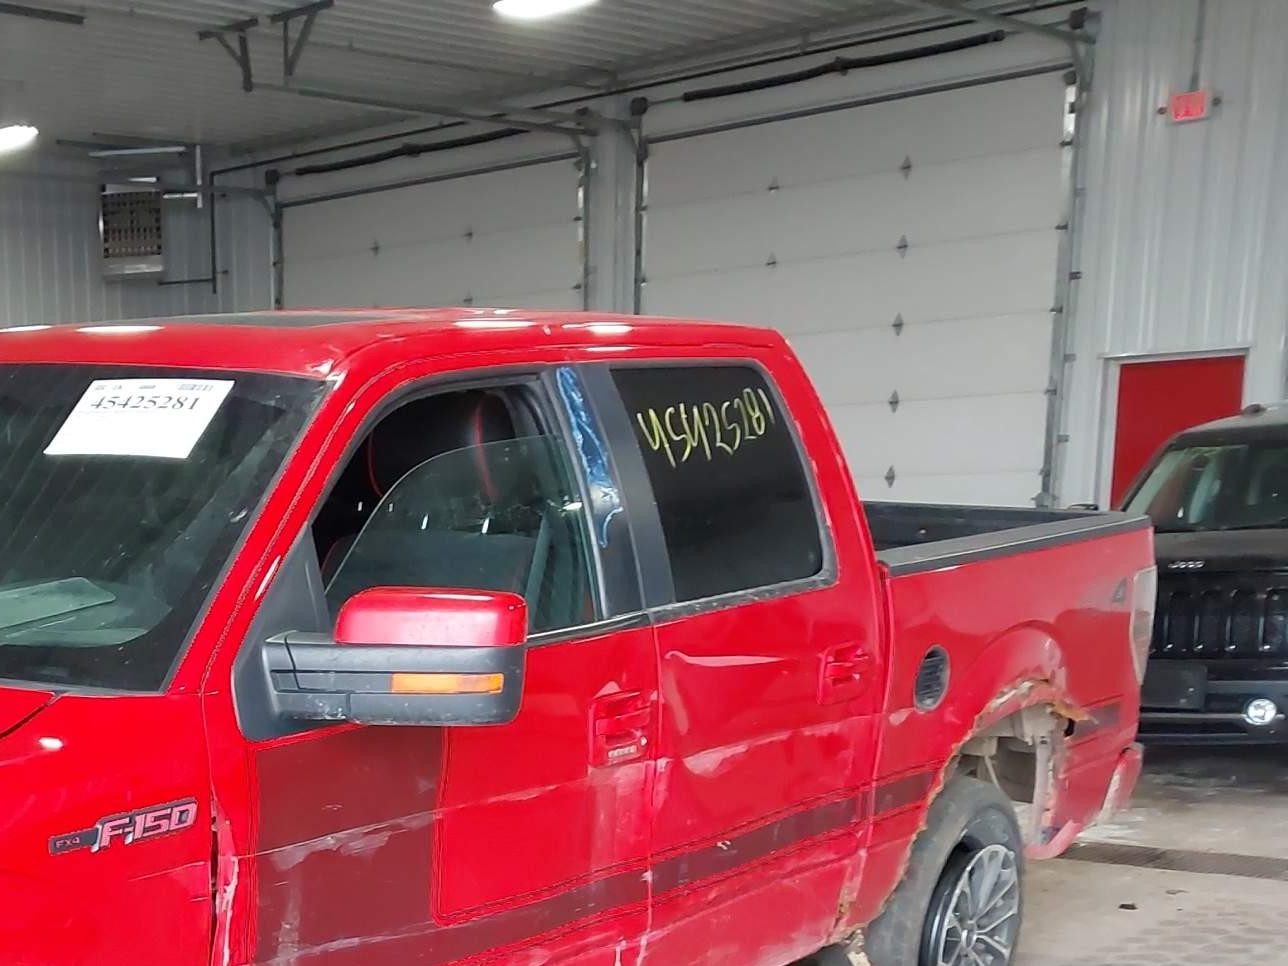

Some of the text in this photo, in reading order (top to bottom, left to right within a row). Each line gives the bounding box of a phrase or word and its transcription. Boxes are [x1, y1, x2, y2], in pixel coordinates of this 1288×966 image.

[90, 395, 200, 410] 45425281
[636, 387, 775, 468] 45425281
[91, 800, 198, 852] F-150
